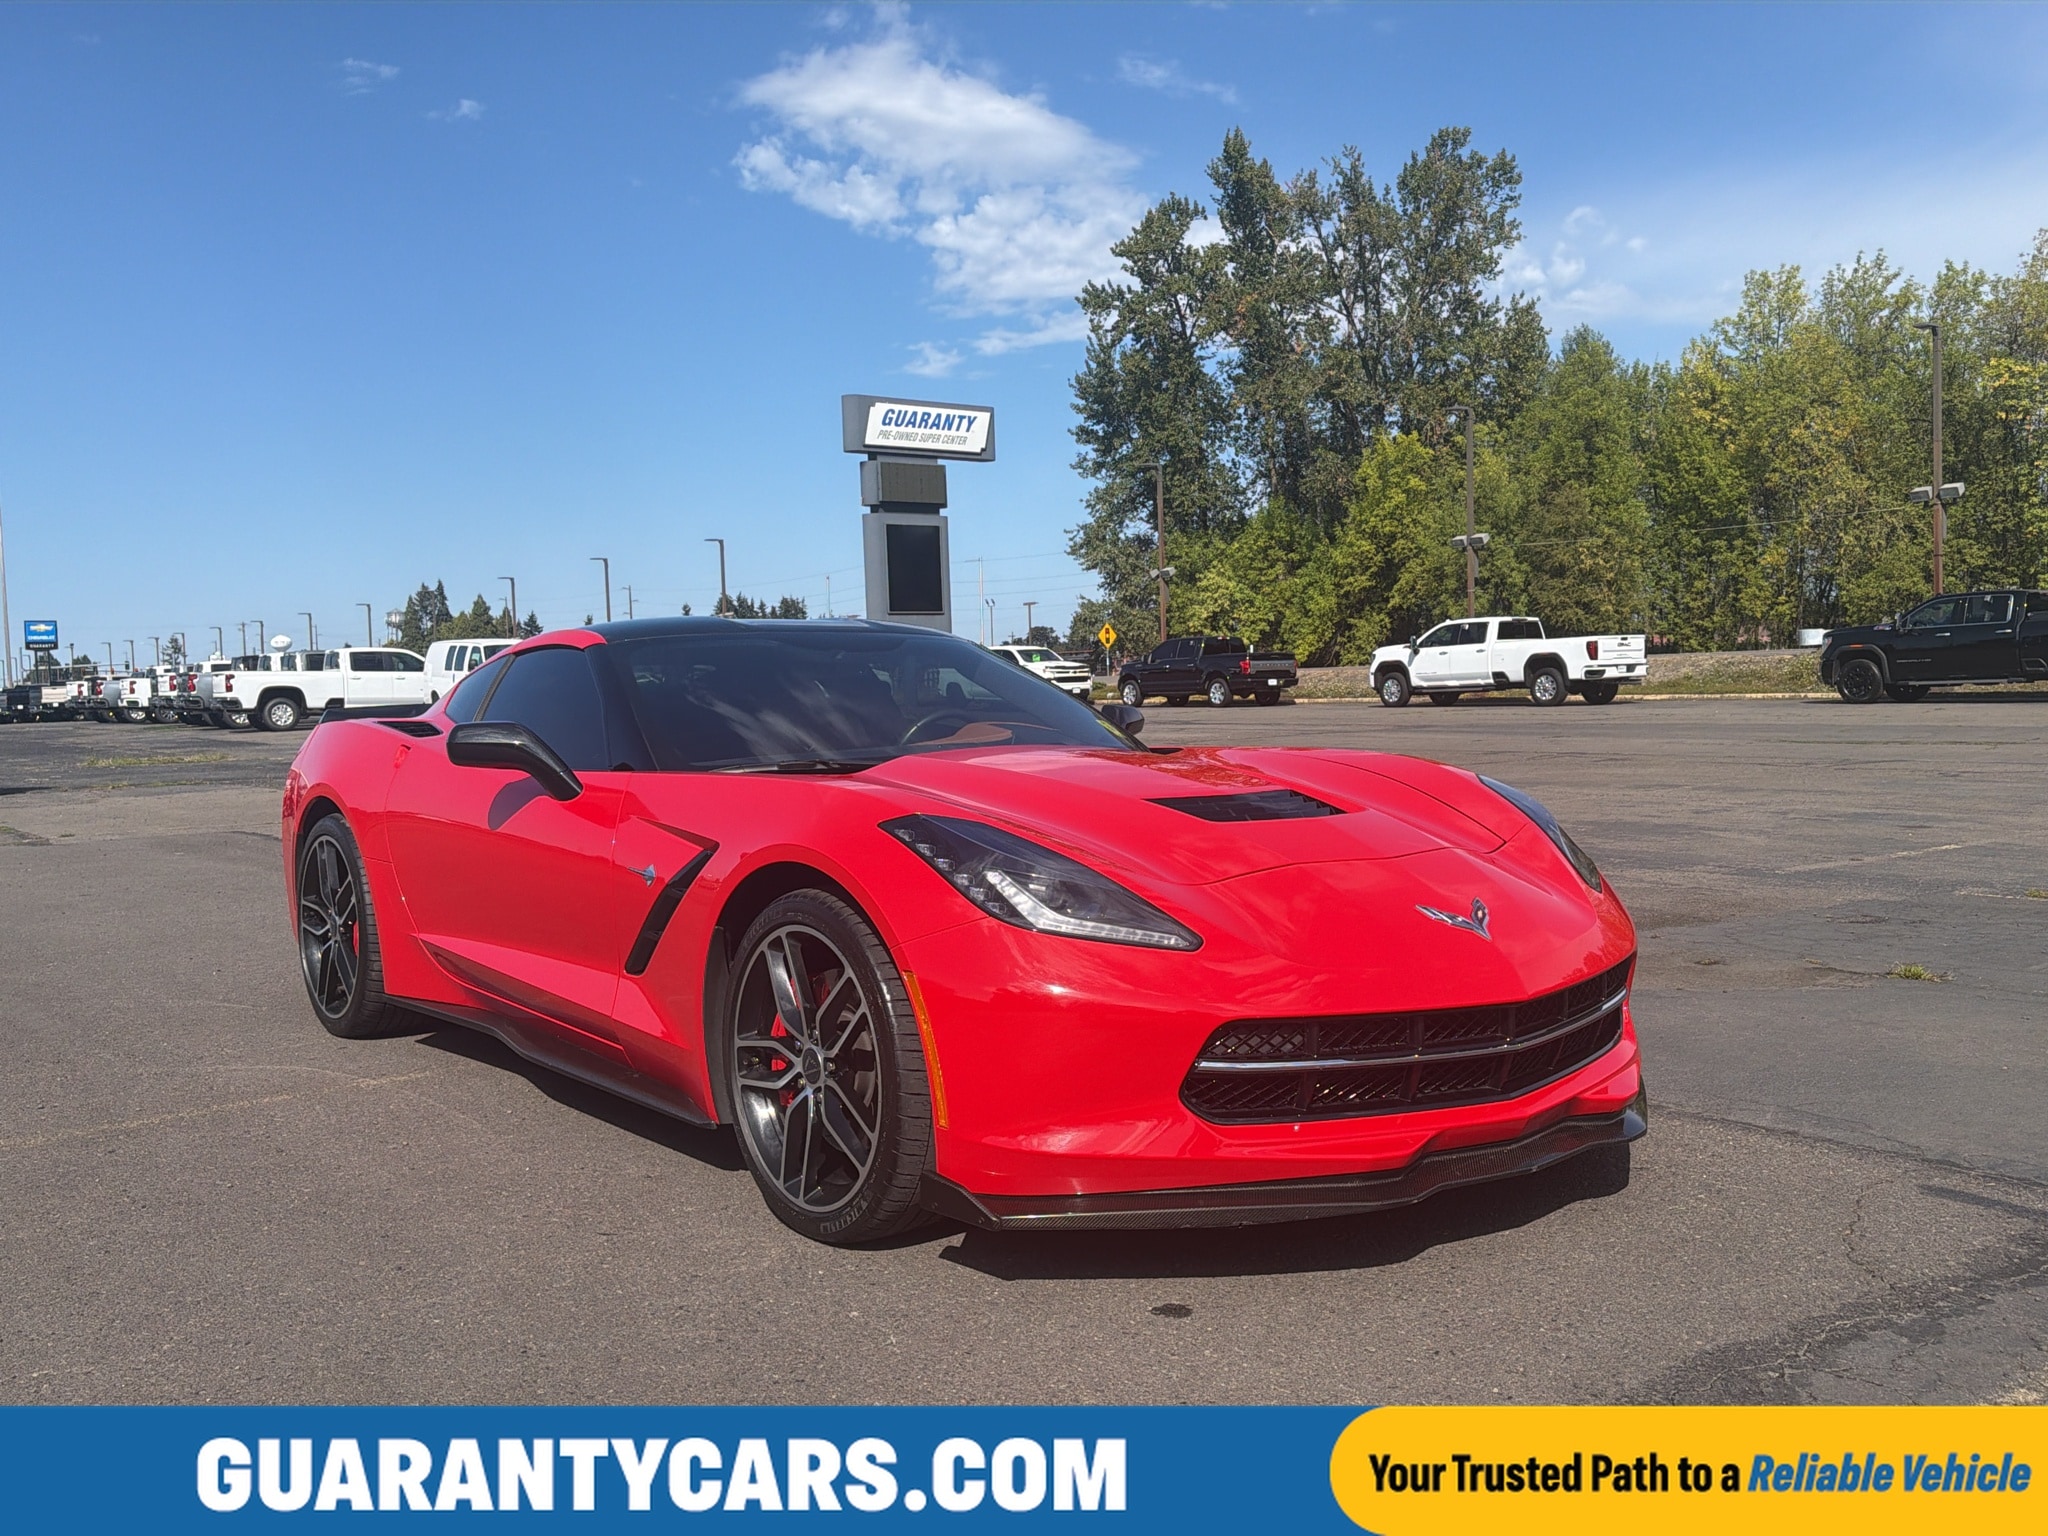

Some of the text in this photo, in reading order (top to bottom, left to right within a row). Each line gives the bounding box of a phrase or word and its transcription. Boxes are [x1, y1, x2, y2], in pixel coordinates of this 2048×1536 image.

[882, 409, 977, 433] GUARANTY
[877, 429, 968, 446] PRE-OWNED SUPER CENTER
